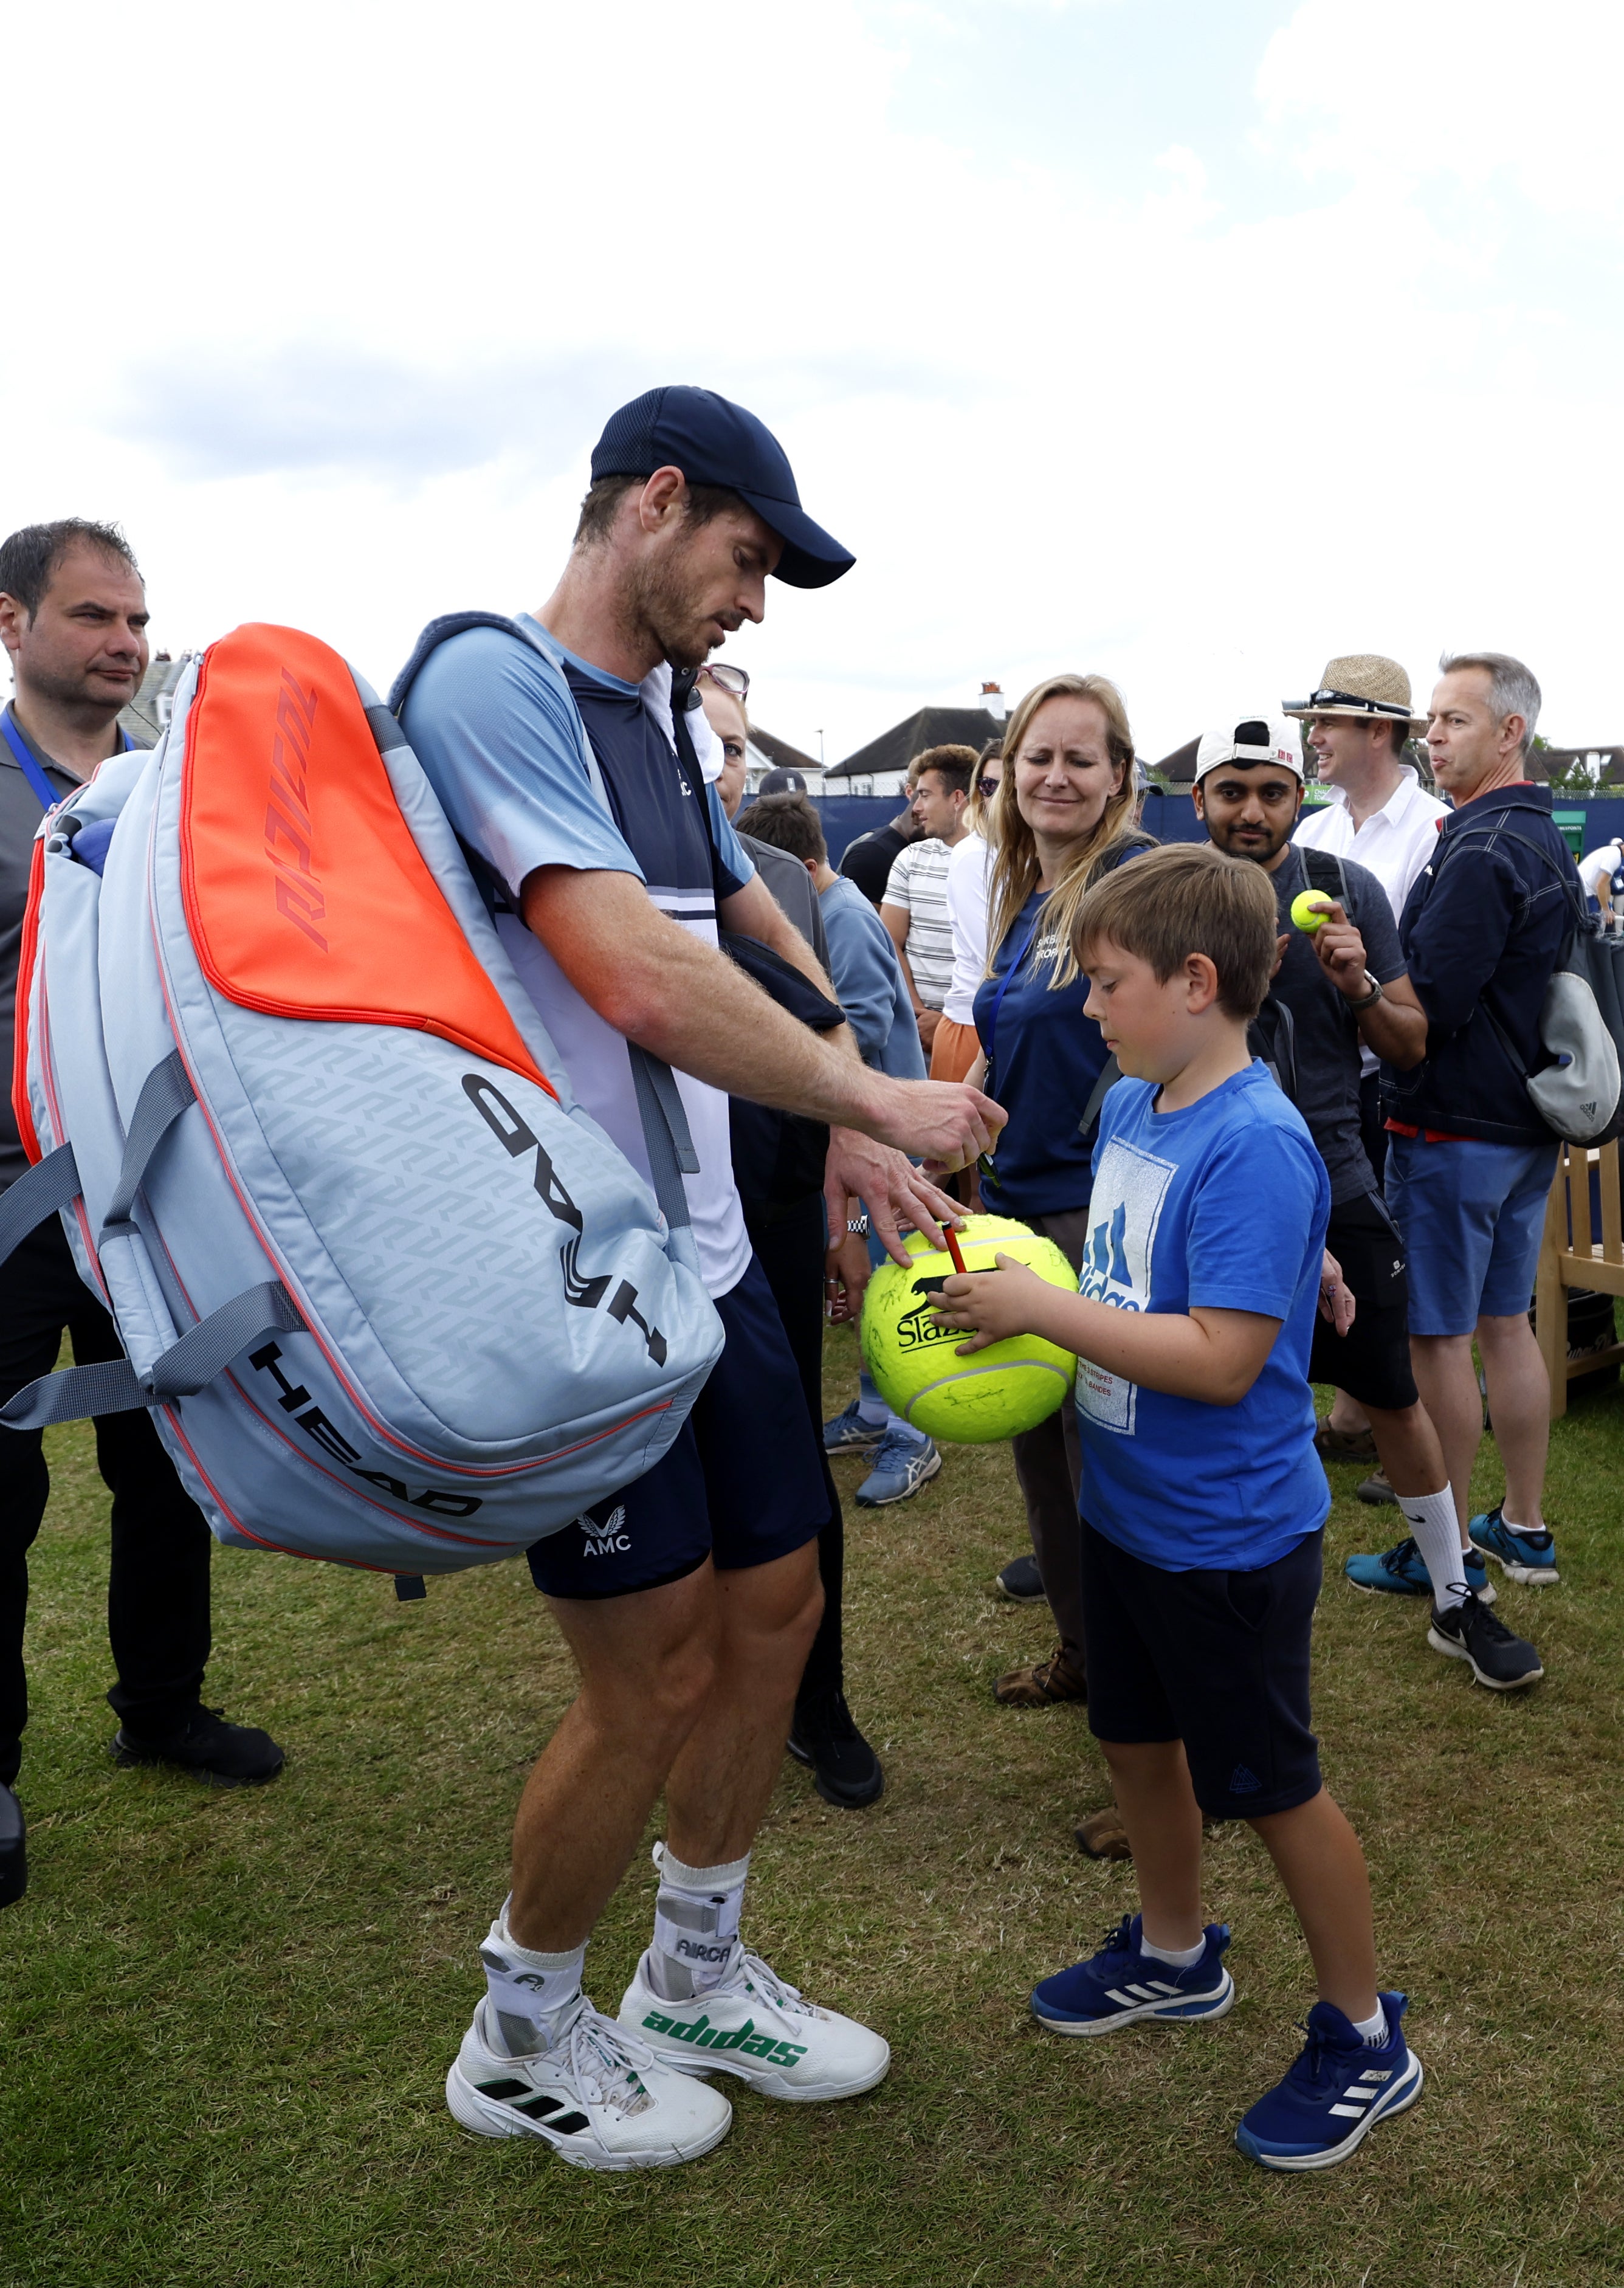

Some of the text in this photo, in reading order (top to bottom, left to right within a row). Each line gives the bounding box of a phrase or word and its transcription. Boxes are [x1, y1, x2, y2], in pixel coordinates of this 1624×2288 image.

[461, 1073, 667, 1367] HEAD
[1089, 1381, 1111, 1396] BANDES
[1090, 1368, 1113, 1384] STRIPES
[248, 1341, 483, 1517] HEAD
[583, 1535, 631, 1557] AMC
[642, 2010, 808, 2067] adidas
